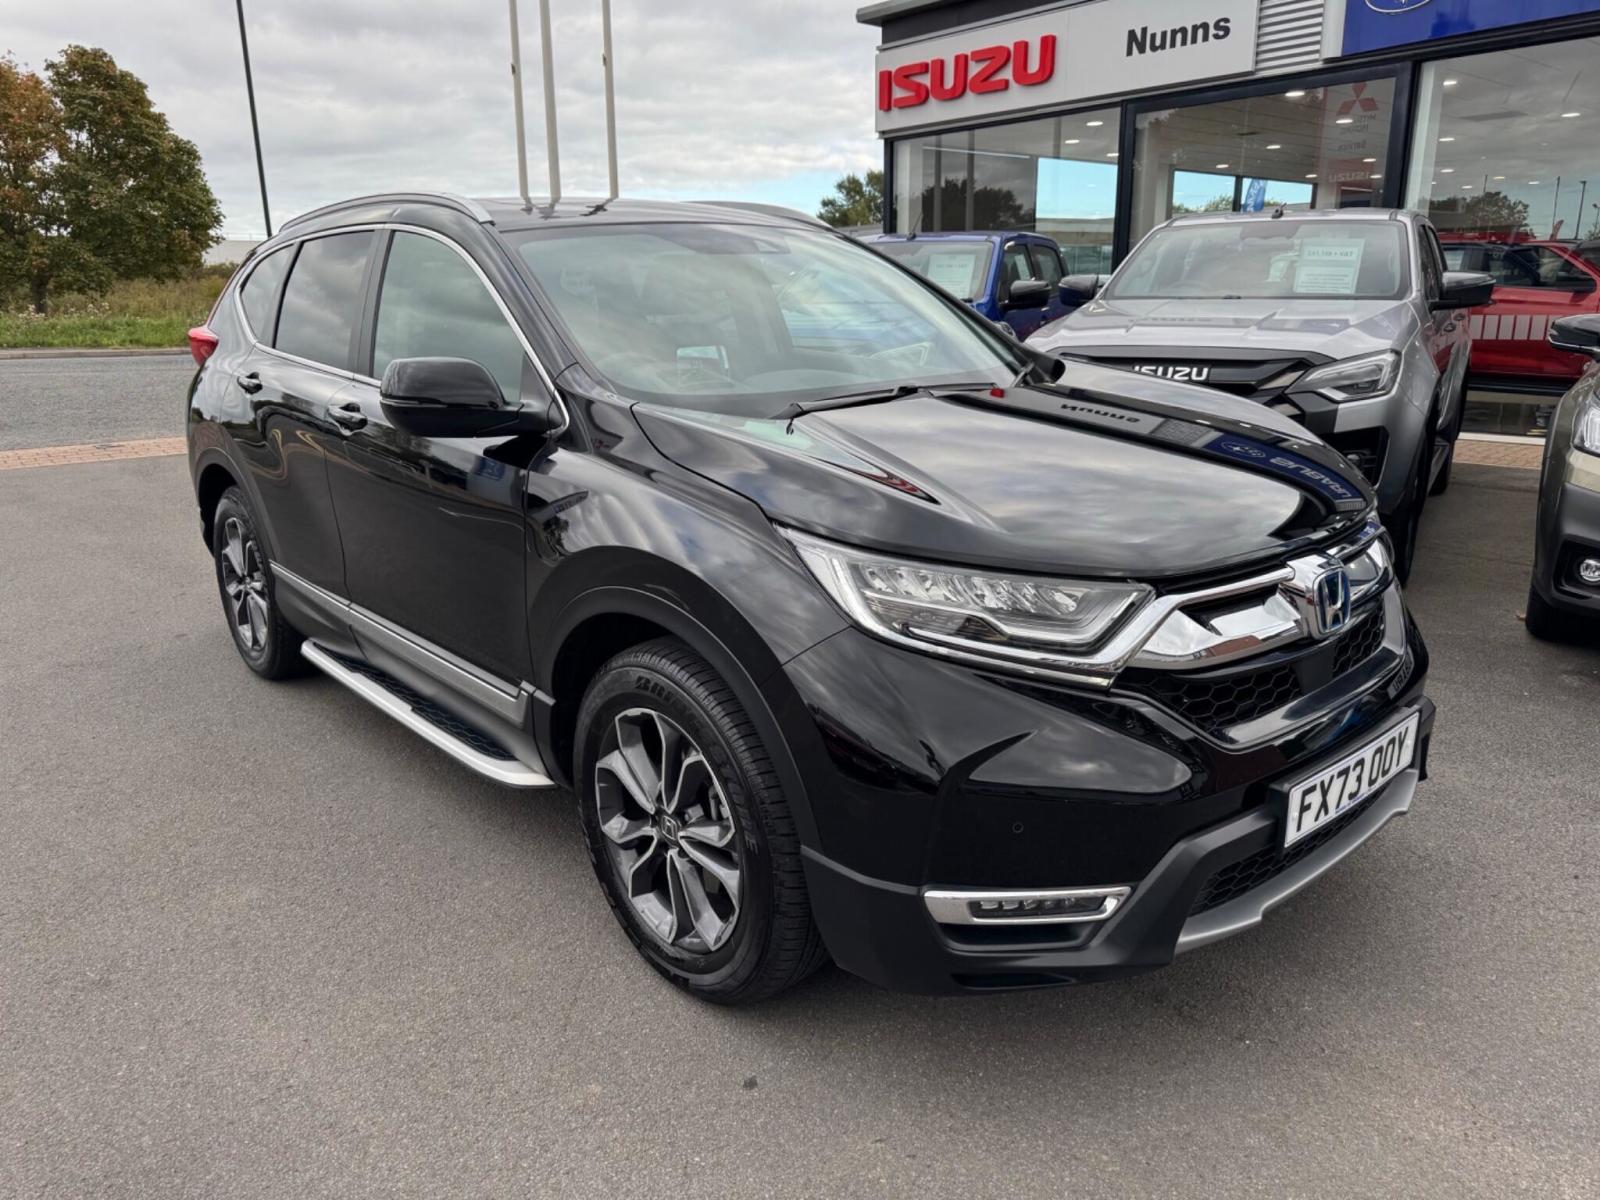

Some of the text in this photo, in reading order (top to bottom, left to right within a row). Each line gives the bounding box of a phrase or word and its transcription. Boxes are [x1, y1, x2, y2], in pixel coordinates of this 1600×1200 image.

[879, 34, 1057, 112] ISUZU
[1125, 17, 1231, 57] Nunns
[1296, 757, 1366, 833] FX73
